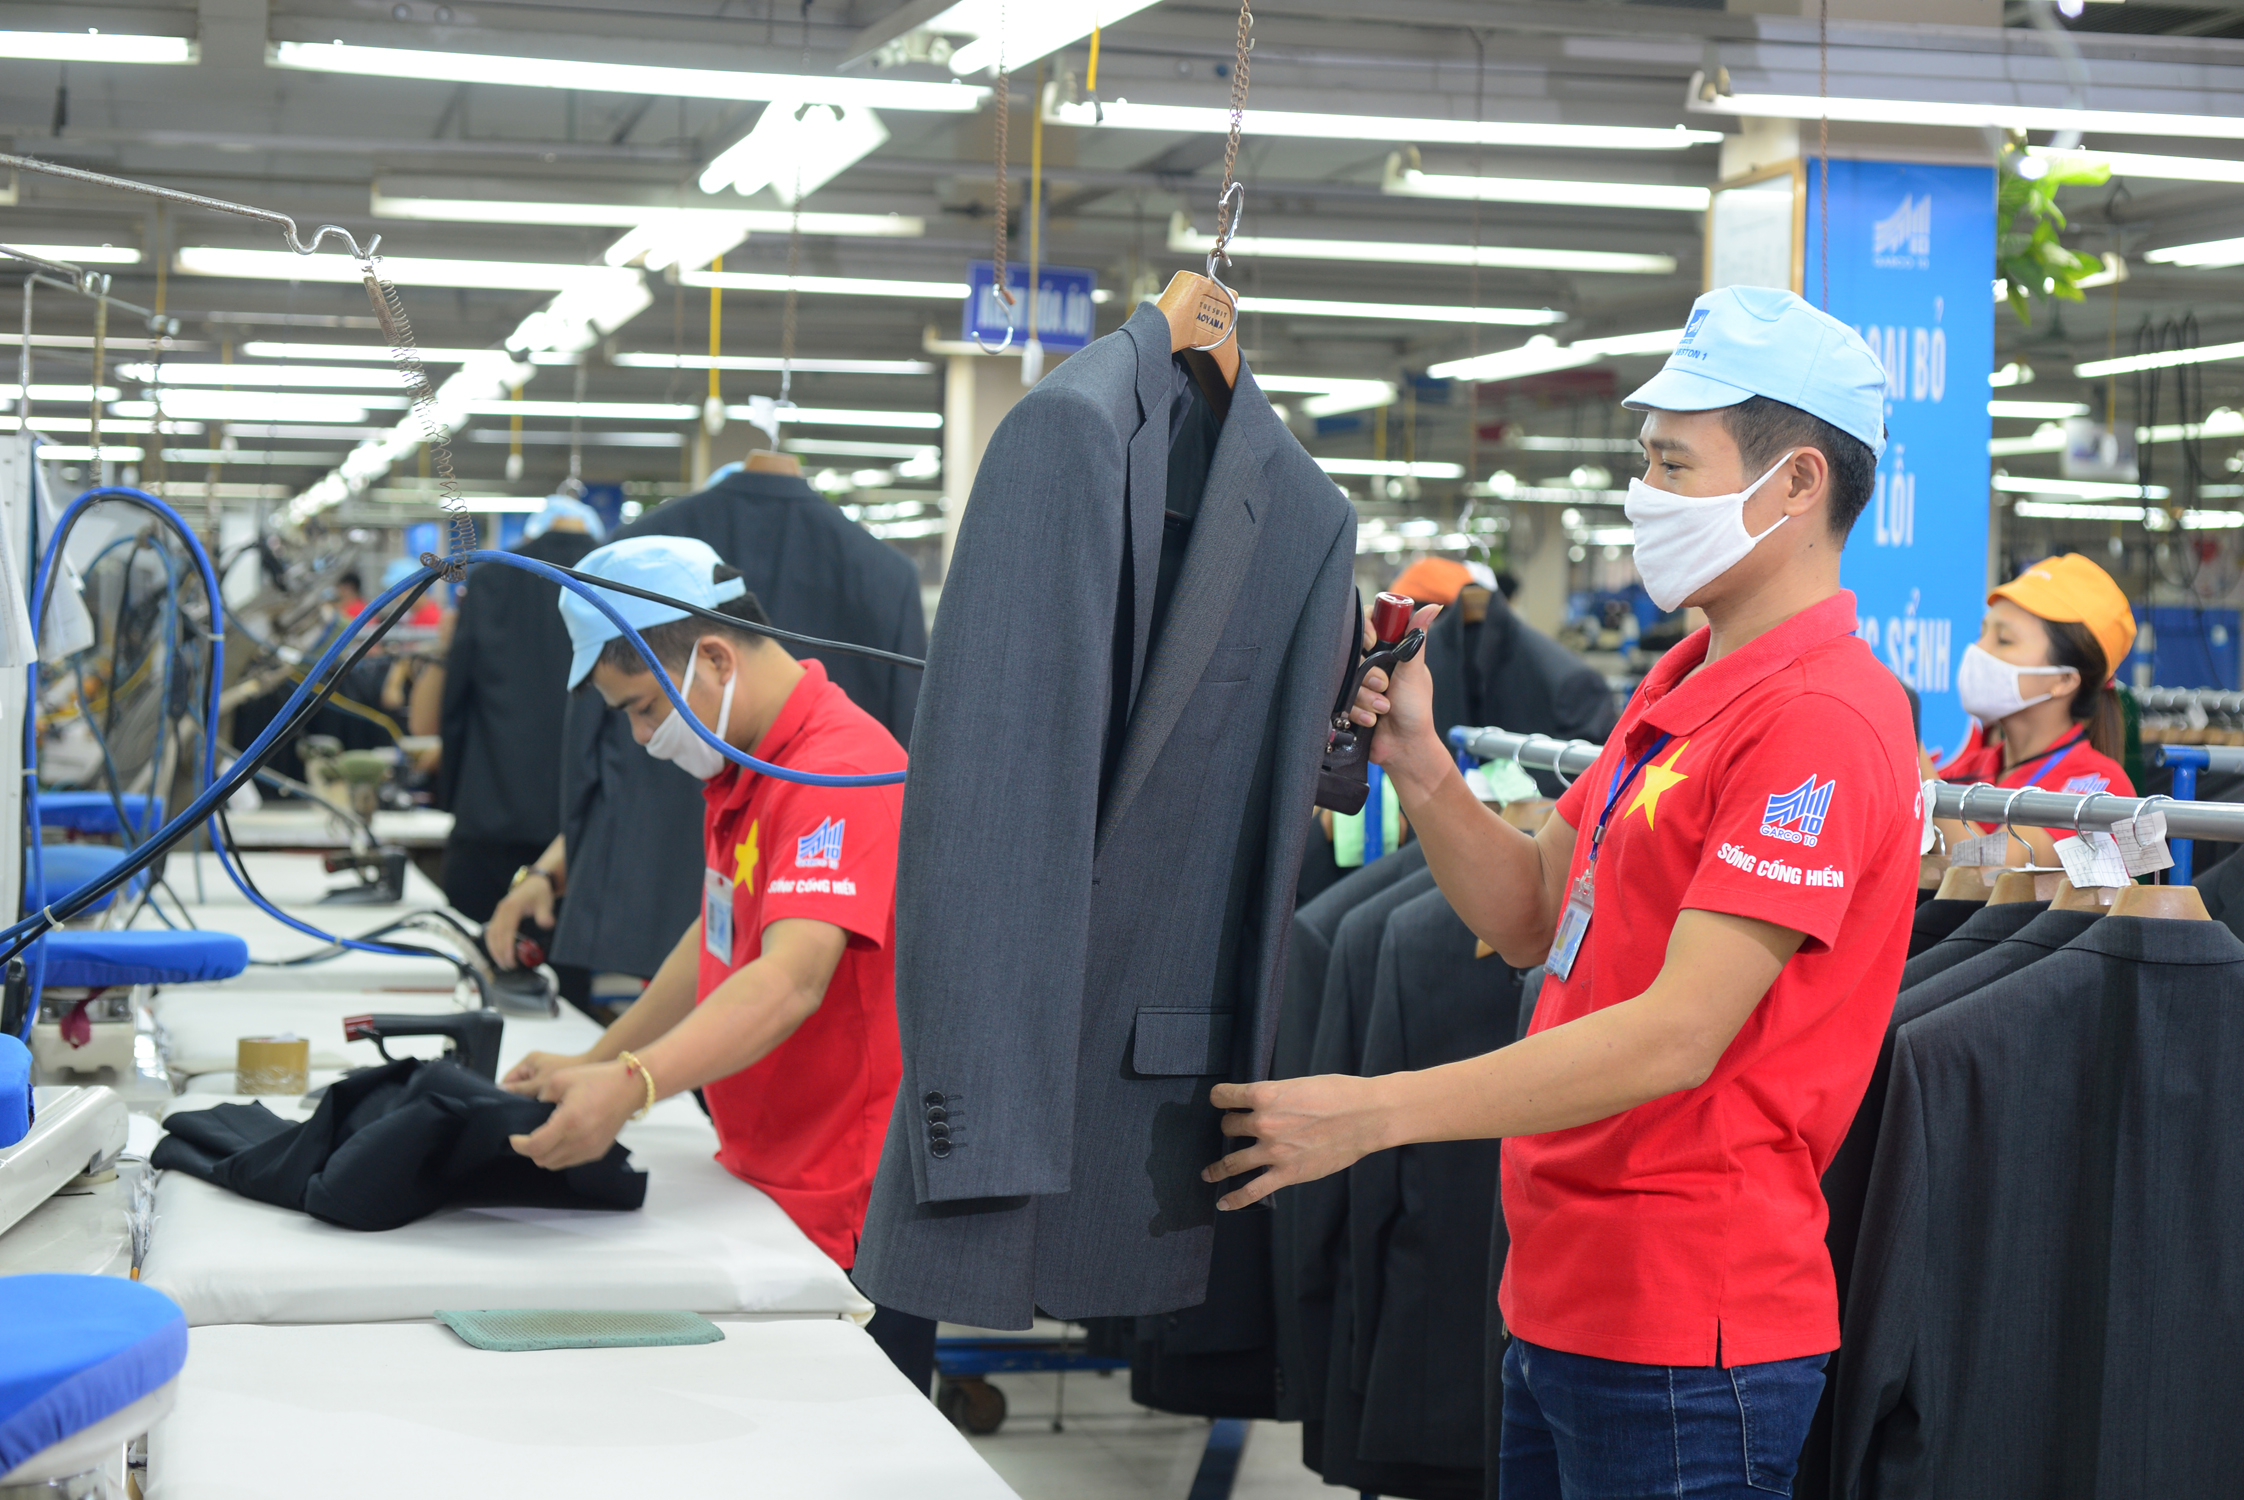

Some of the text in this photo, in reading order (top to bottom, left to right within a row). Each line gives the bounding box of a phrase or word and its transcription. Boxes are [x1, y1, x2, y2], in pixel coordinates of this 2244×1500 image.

[1196, 312, 1224, 330] AOYAMA
[1912, 296, 1946, 403] BỎ
[1760, 825, 1818, 847] GARCO 10
[1717, 842, 1844, 888] SỐNG CỐNG HIẾN
